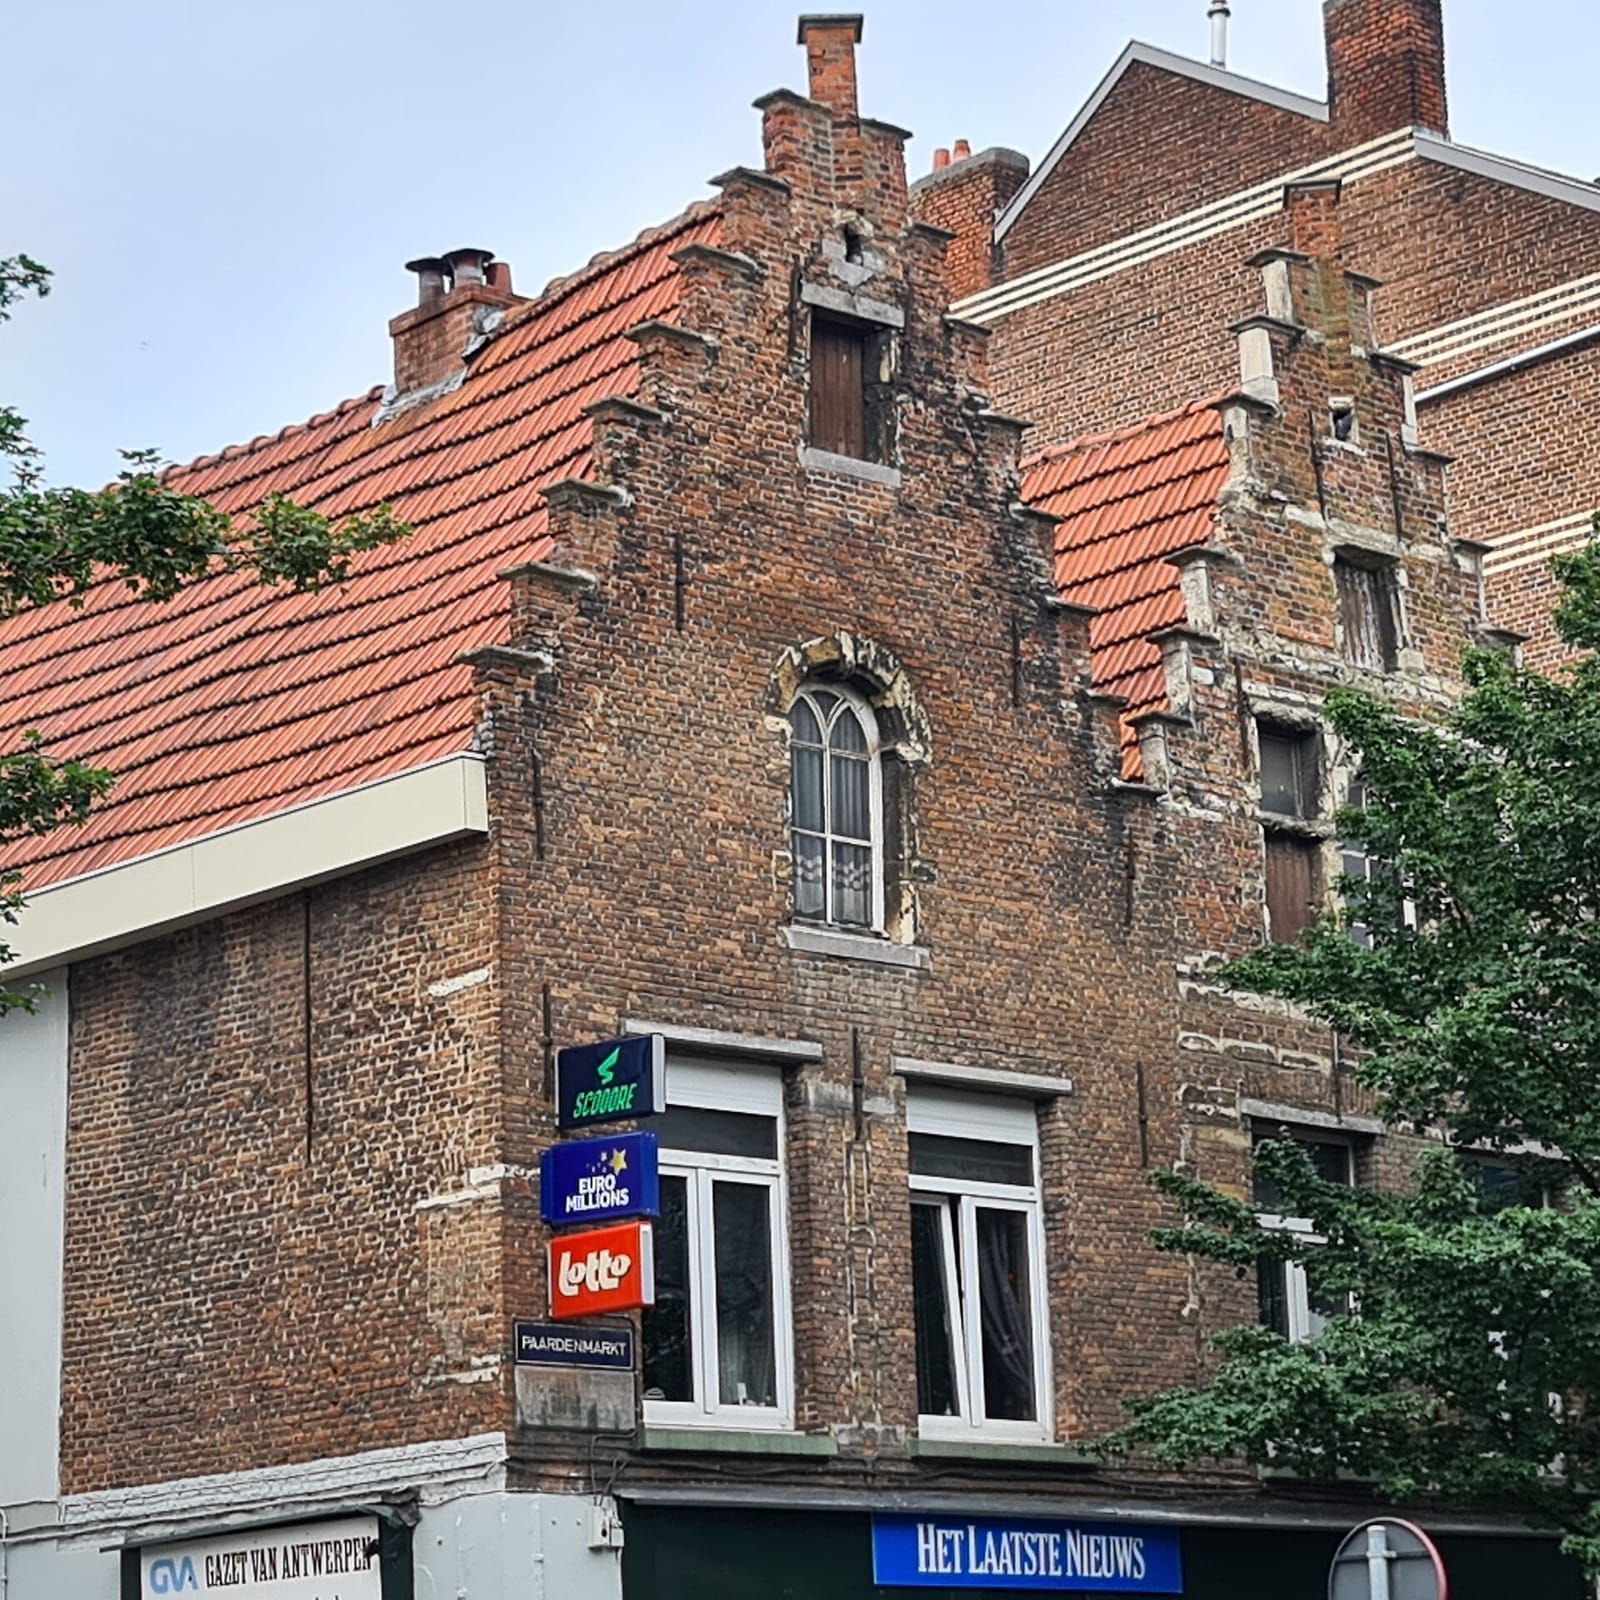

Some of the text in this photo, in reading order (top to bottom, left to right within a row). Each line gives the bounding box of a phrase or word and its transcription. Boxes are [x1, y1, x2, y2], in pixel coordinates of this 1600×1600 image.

[573, 1083, 637, 1119] SCOOORE
[565, 1187, 630, 1213] MILLIONS
[578, 1173, 616, 1195] EURO
[558, 1249, 631, 1296] Lotto
[521, 1334, 626, 1357] PAARDENMARKT
[204, 1535, 373, 1589] GAZET VAN ANTWERPEN
[916, 1523, 1146, 1580] HET LAATSTE NIEUWS
